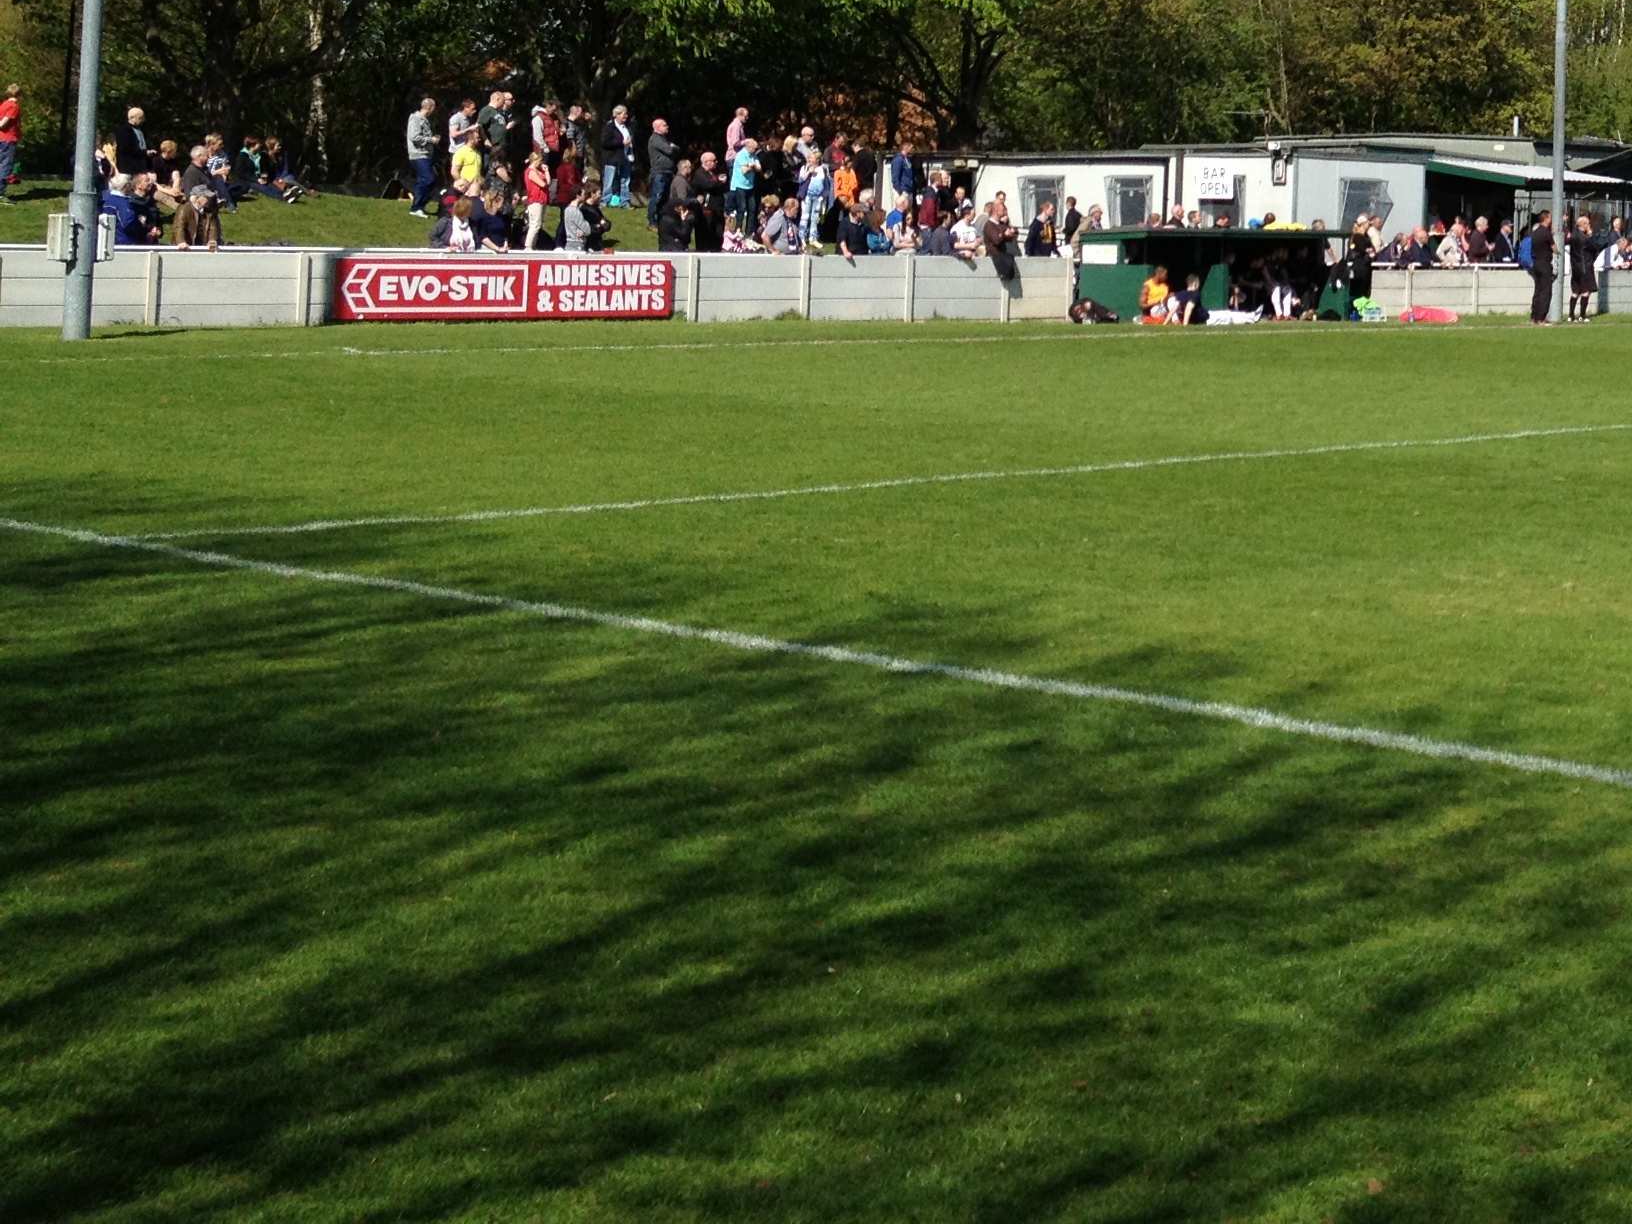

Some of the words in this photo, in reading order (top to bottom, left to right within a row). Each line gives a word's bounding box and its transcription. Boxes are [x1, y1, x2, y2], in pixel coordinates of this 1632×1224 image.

[1203, 167, 1226, 180] BAR
[1200, 182, 1228, 195] OPEN
[537, 263, 666, 286] ADHESIVES
[378, 275, 516, 301] EVO-STIK
[537, 290, 553, 312] &
[558, 289, 665, 312] SEALANTS
